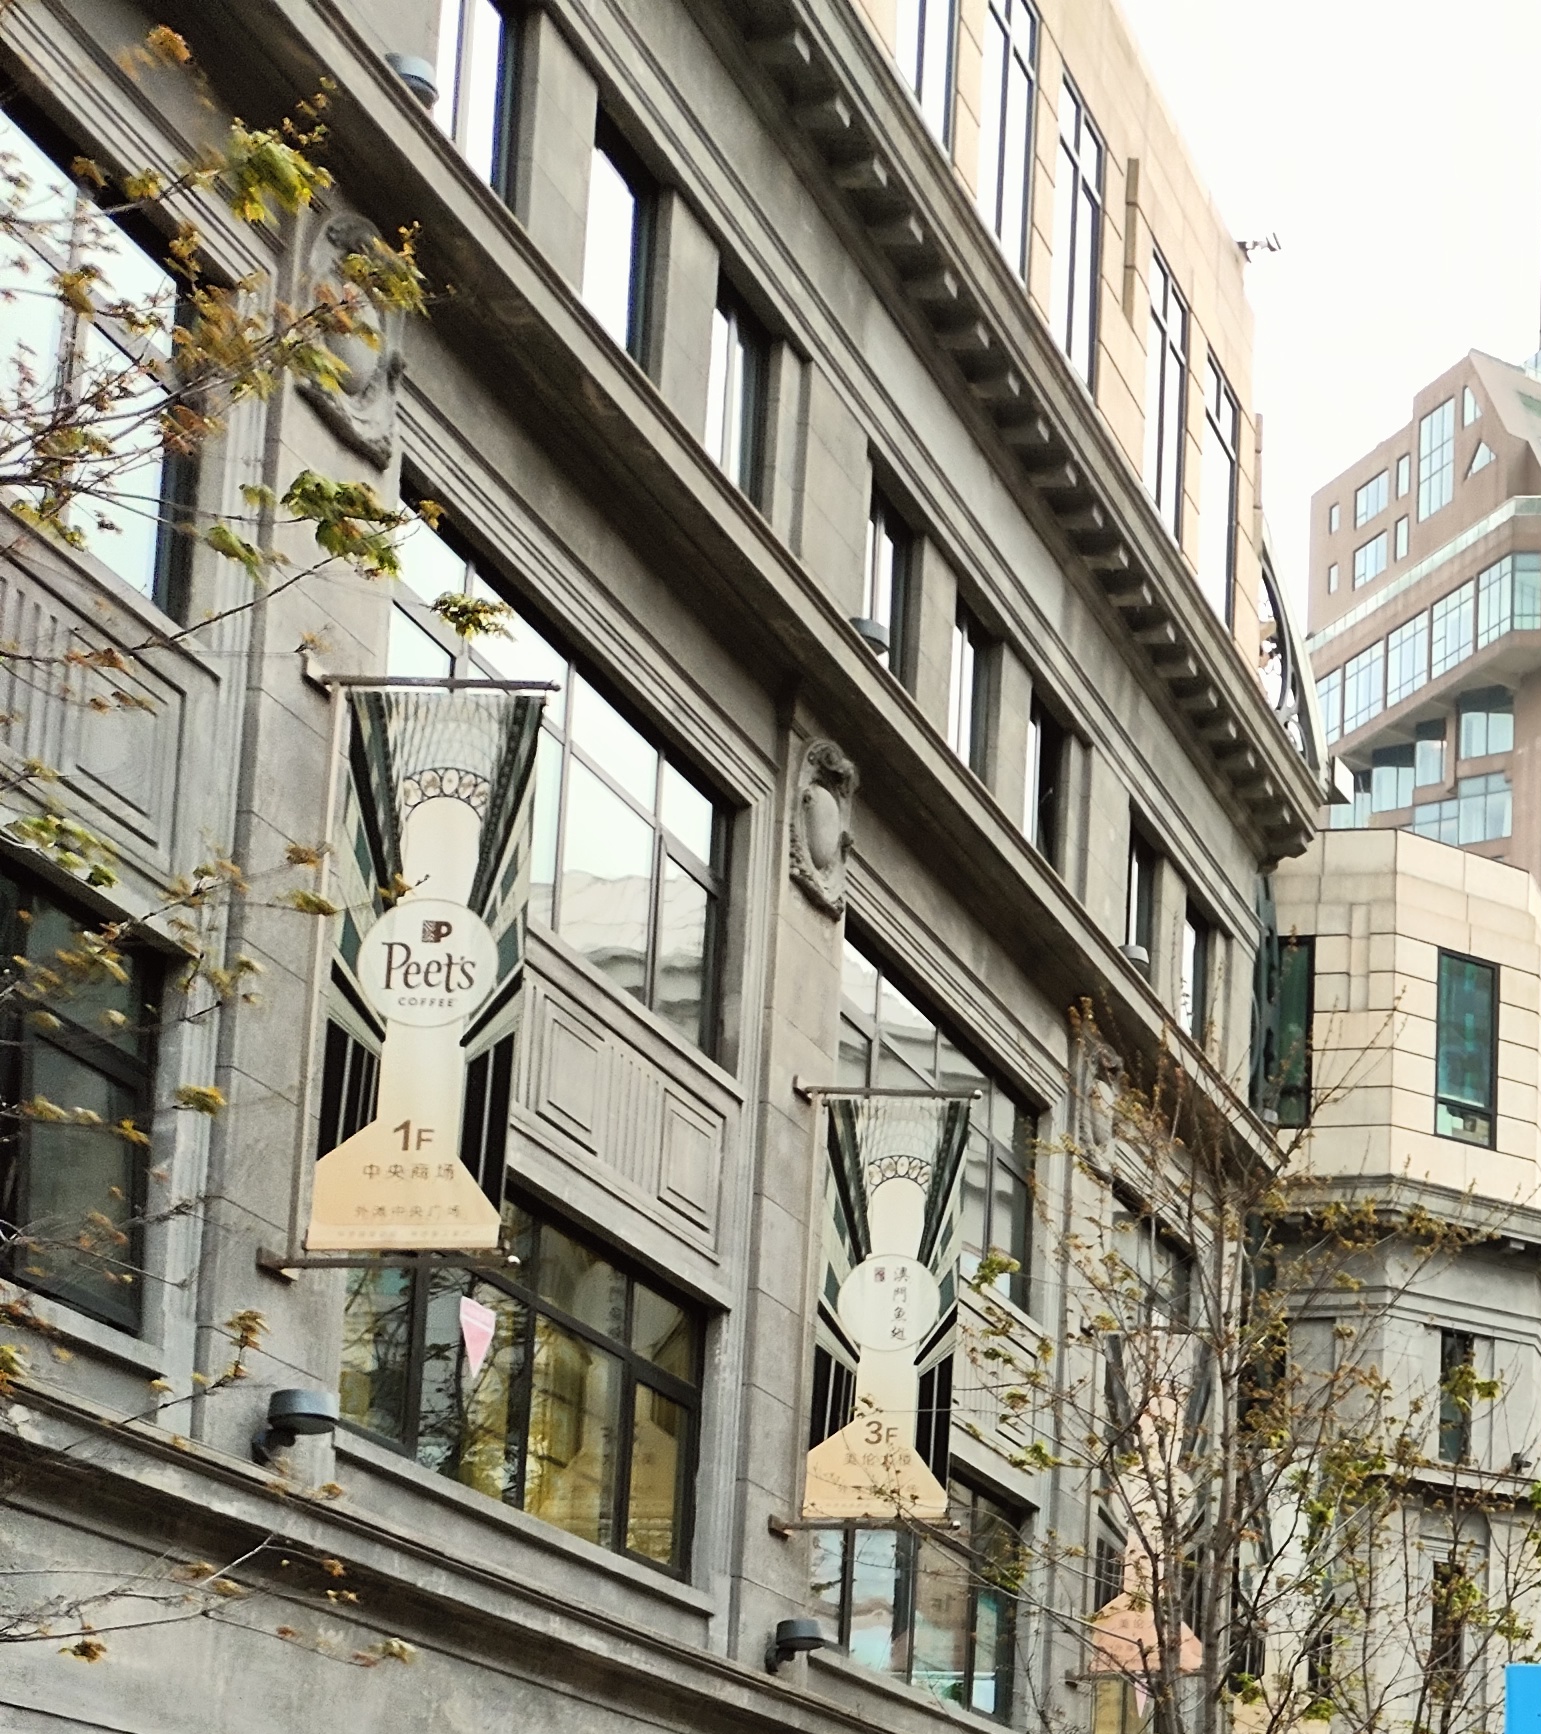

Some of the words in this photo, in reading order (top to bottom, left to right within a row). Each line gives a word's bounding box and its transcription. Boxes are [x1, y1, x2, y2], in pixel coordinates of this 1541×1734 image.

[381, 941, 476, 993] Peet's
[397, 996, 454, 1007] COFFEE
[393, 1119, 435, 1151] 1F
[363, 1163, 455, 1180] 中央商场
[864, 1420, 899, 1445] 3F
